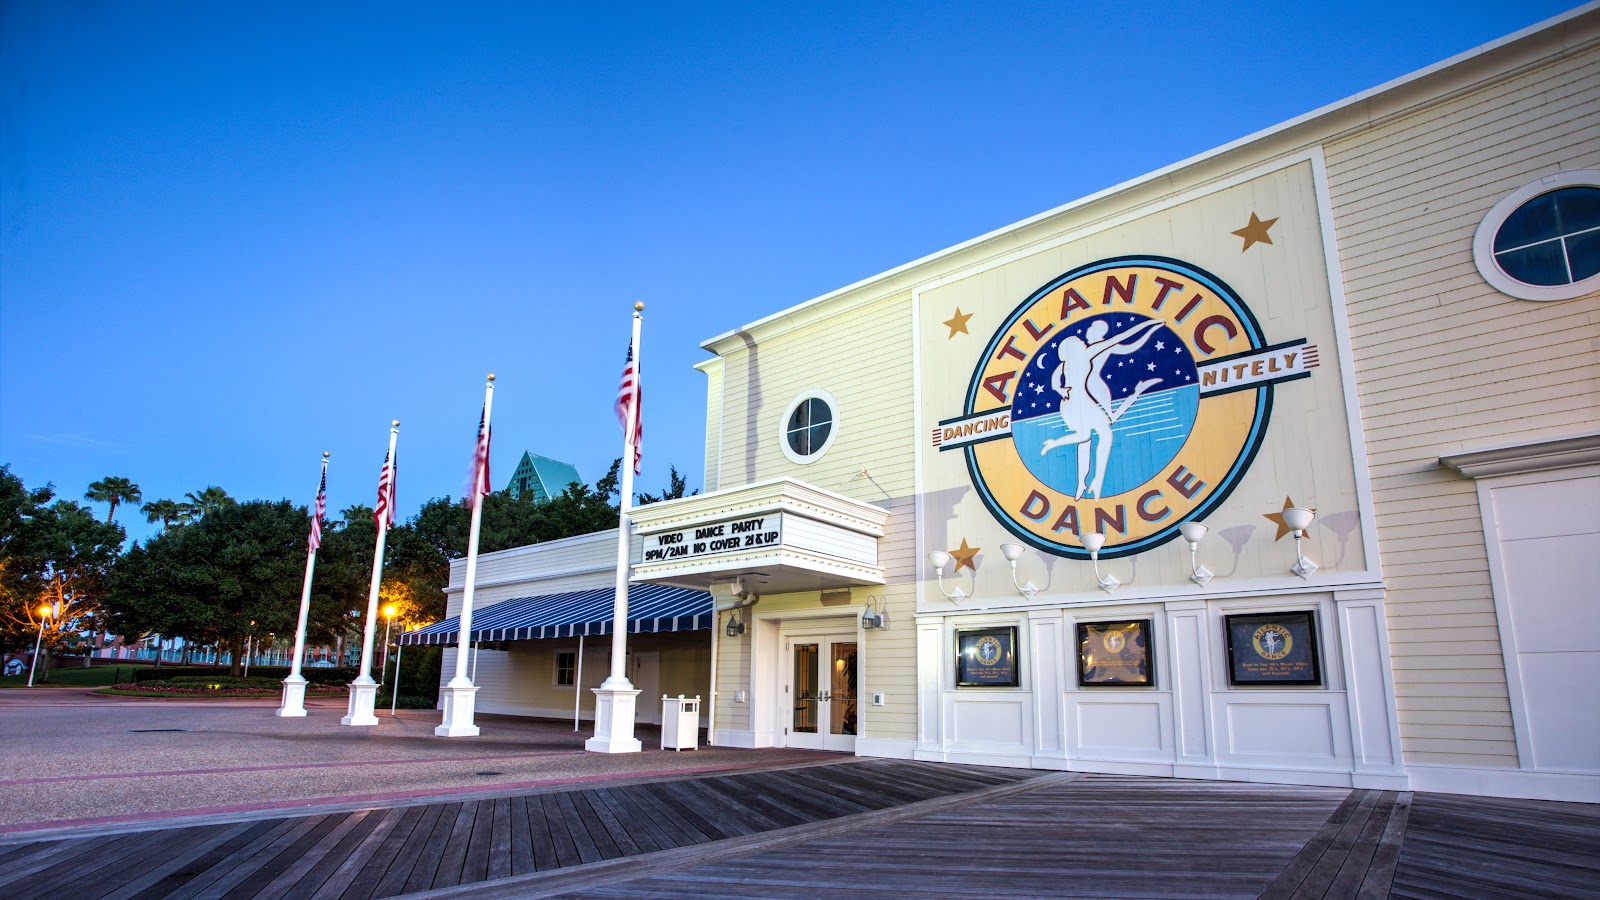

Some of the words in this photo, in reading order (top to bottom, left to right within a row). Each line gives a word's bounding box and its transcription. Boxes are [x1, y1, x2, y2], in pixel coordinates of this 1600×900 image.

[983, 273, 1238, 404] ATLANTIC
[943, 414, 1010, 441] DANCING
[1202, 352, 1298, 387] NITELY
[1020, 464, 1207, 536] DANCE
[658, 532, 683, 546] VIDEO
[695, 525, 725, 540] DANCE
[731, 518, 765, 534] PARTY
[645, 545, 688, 561] 9PM/2AM
[693, 543, 707, 554] NO
[709, 536, 741, 551] COVER
[976, 637, 1001, 649] ATLANTIC
[1254, 625, 1290, 640] ATLANTIC
[1261, 651, 1286, 659] DANCE
